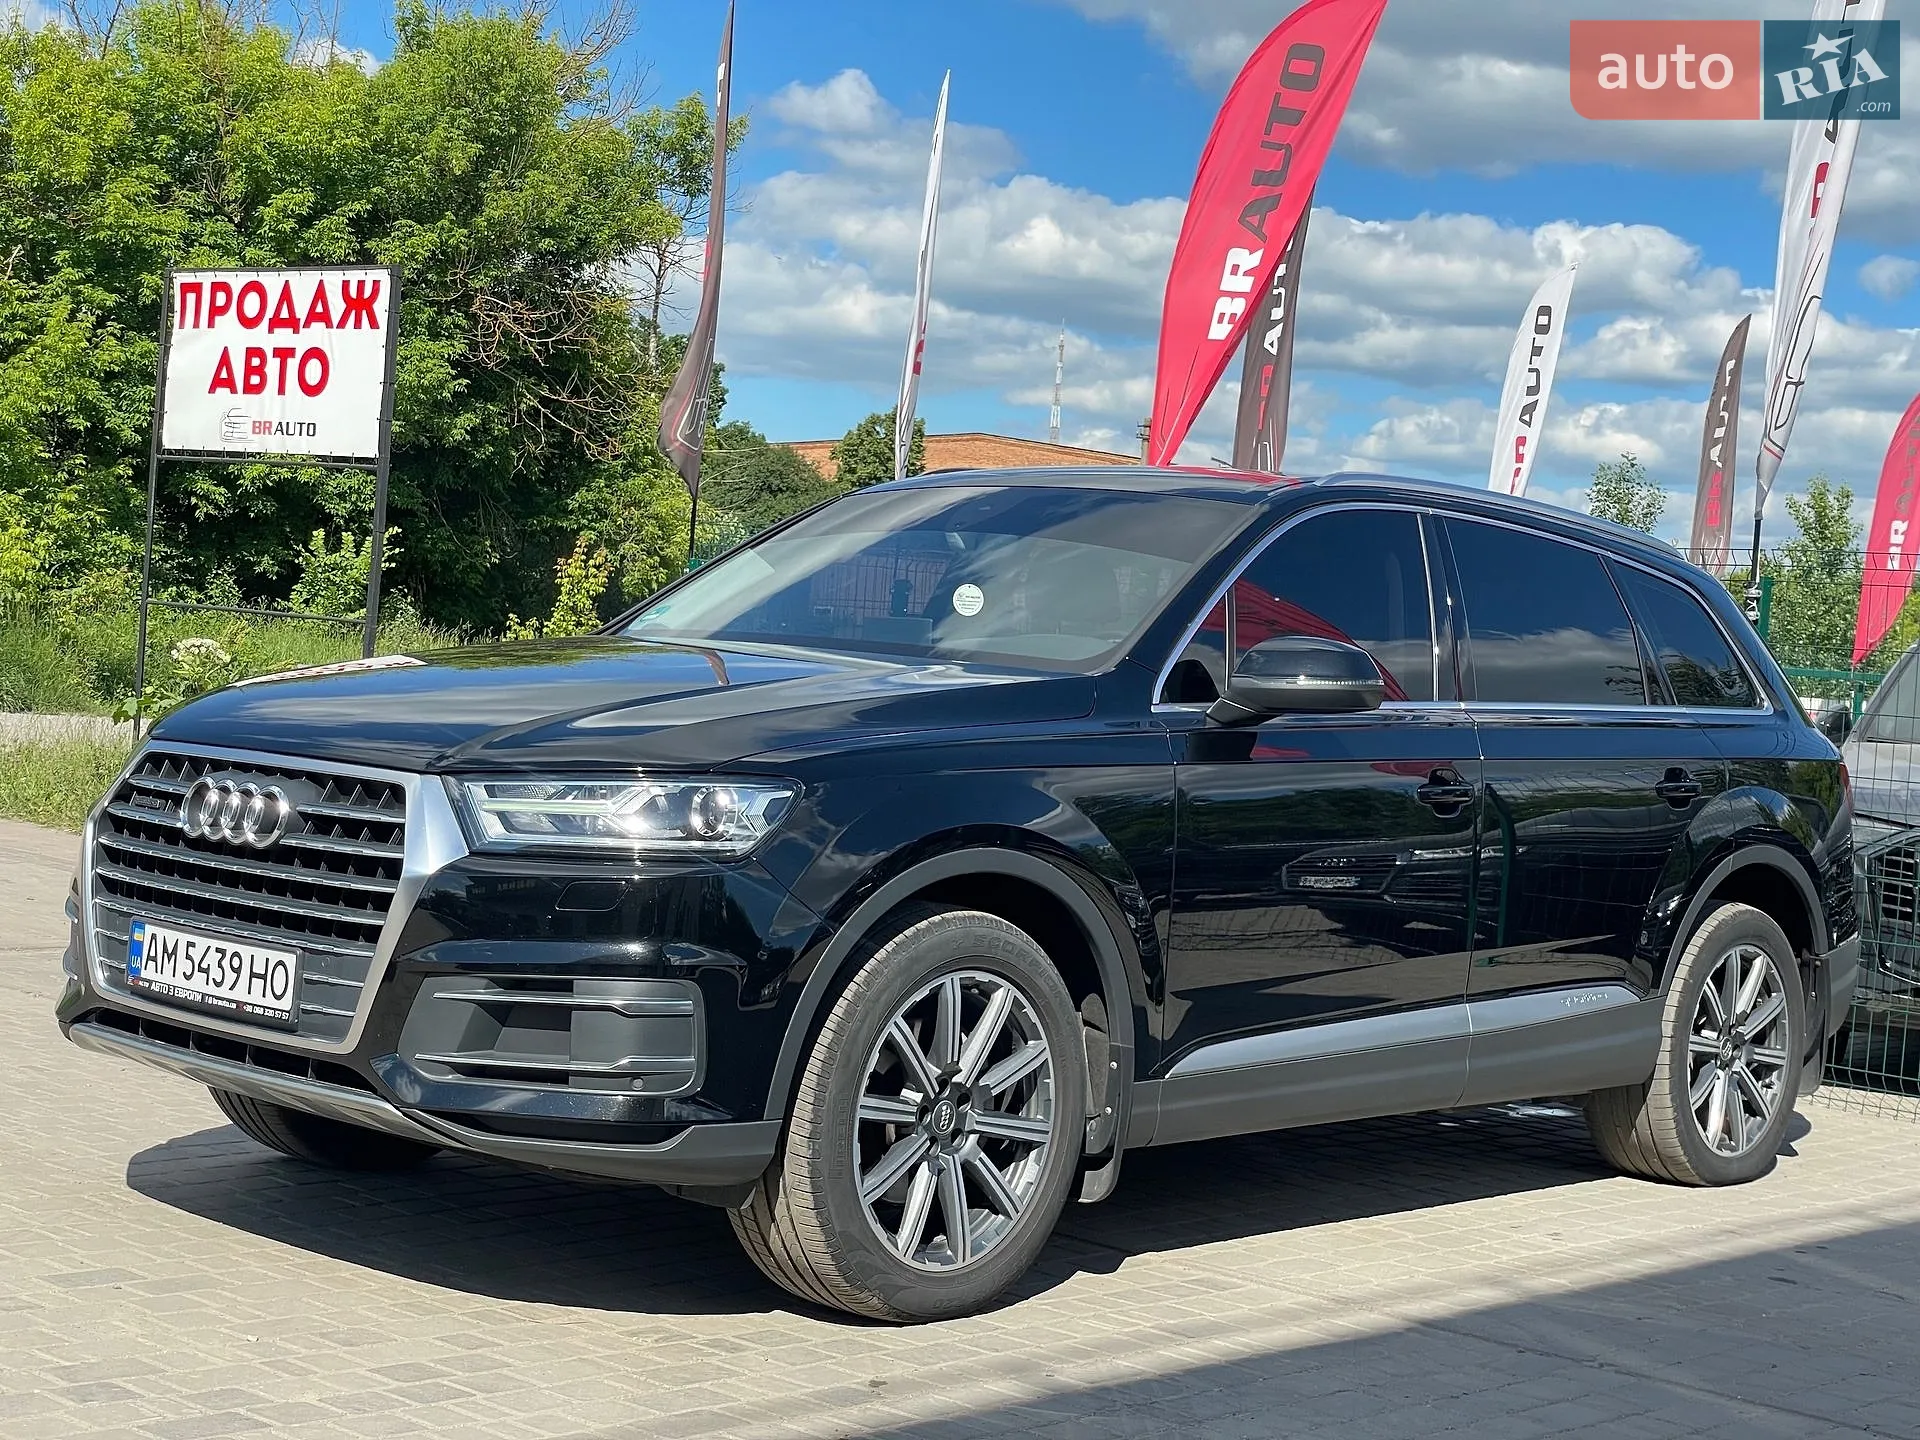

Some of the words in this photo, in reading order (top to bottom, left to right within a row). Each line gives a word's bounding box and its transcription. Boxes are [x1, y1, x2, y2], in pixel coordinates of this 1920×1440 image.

[178, 279, 381, 334] ПРОДАЖ
[208, 346, 330, 397] АВТО
[131, 955, 142, 969] UA
